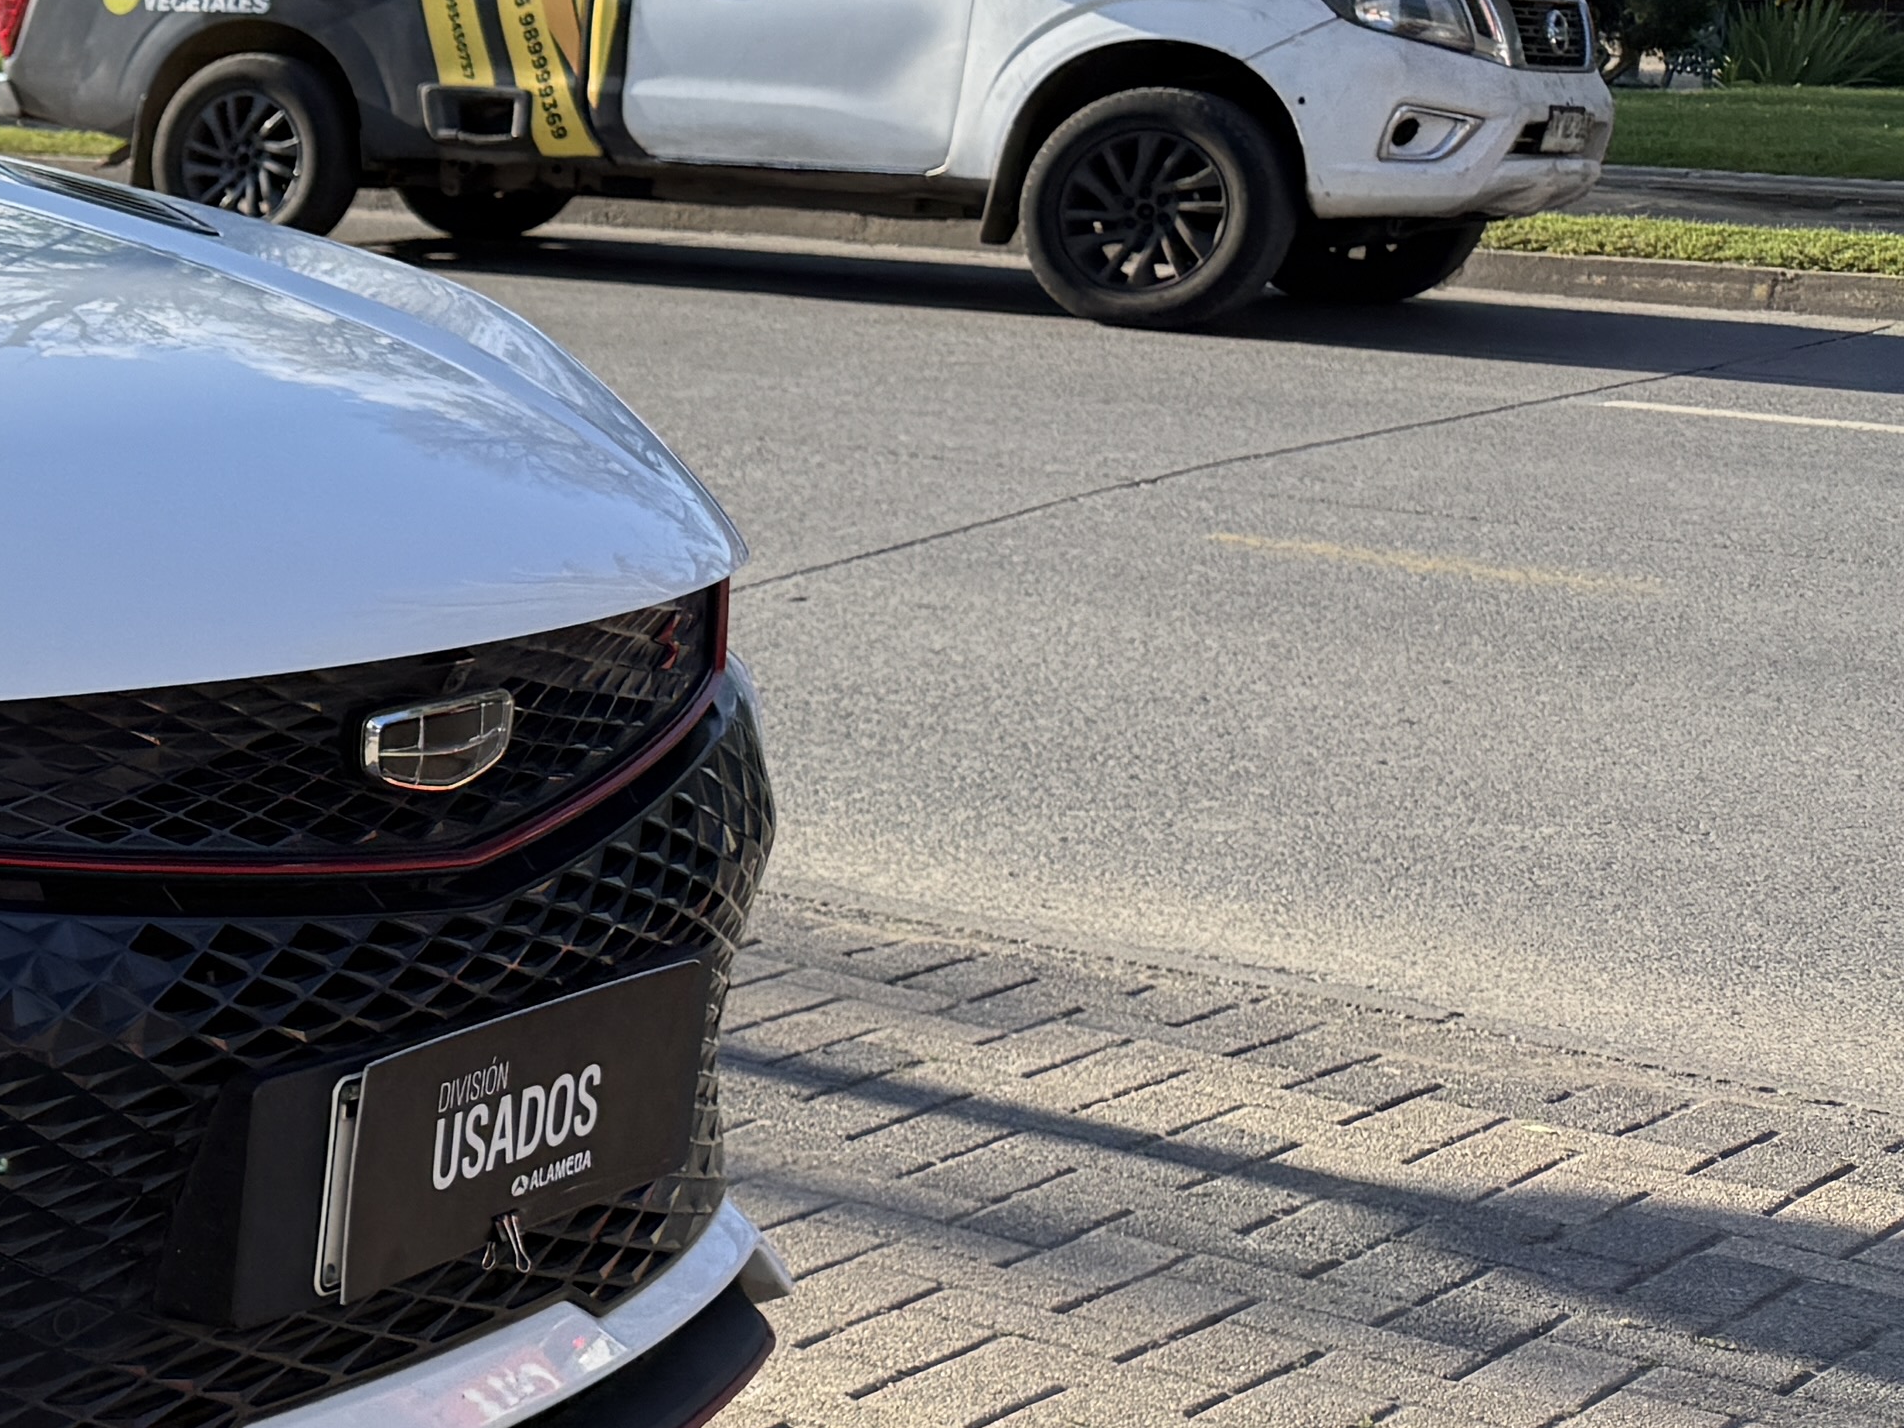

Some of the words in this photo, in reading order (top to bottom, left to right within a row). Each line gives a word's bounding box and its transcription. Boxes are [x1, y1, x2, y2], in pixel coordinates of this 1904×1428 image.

[438, 1056, 509, 1113] DIVISIÓN
[432, 1063, 602, 1190] USADOS
[529, 1149, 592, 1190] ALAMEDA
